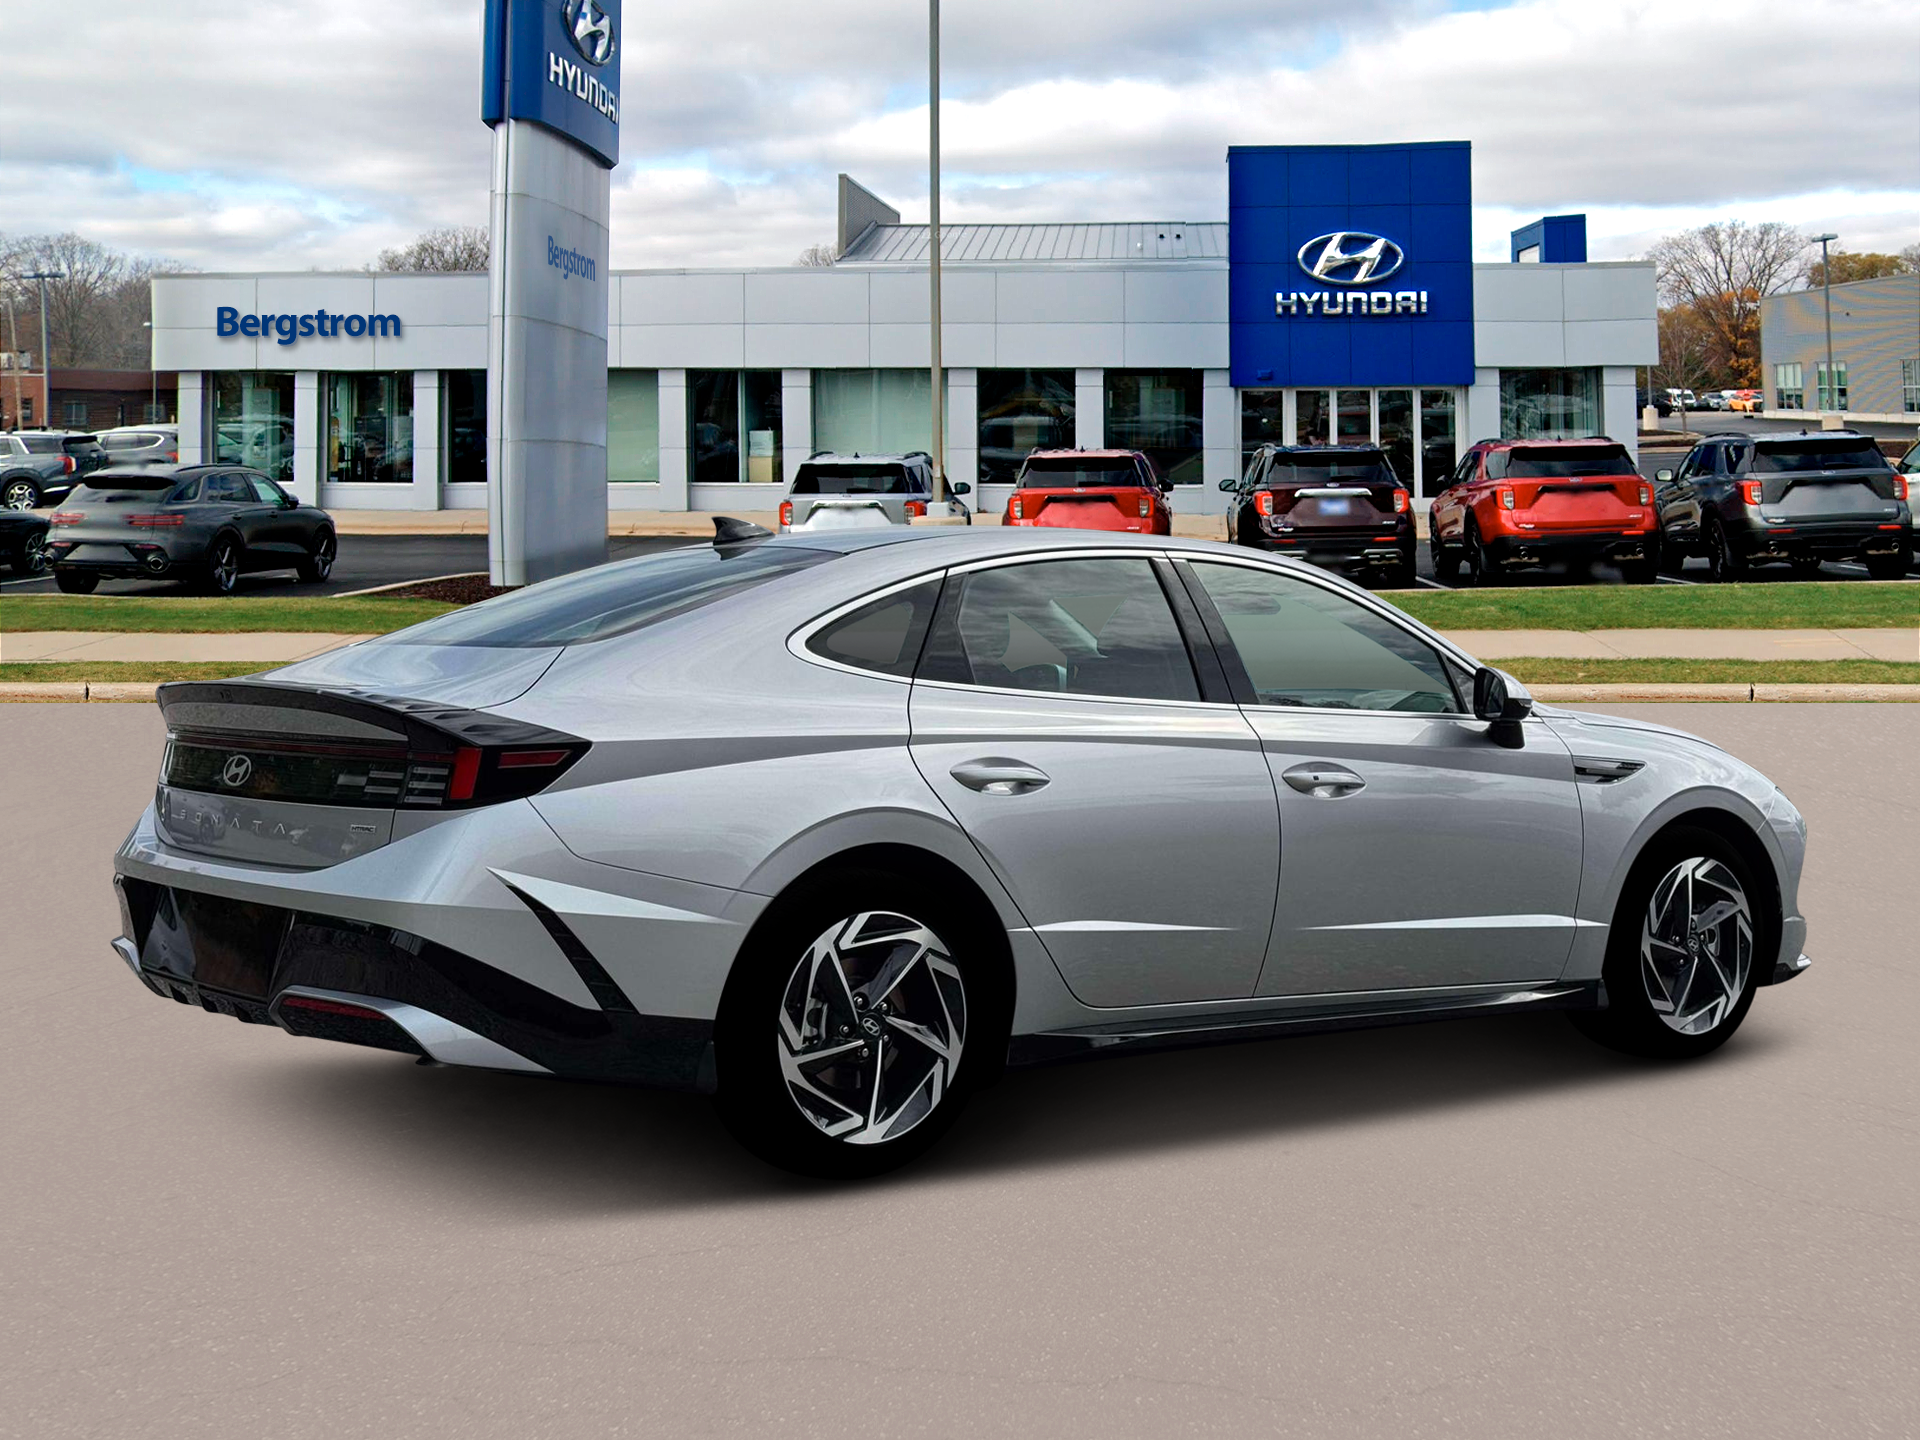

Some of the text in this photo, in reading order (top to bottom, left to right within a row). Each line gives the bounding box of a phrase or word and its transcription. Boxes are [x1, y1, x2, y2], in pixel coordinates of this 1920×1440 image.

[549, 51, 619, 124] HYUNDAI
[547, 235, 595, 282] Bergstrom
[1275, 290, 1428, 315] HYUNDAI
[216, 306, 401, 346] Bergstrom
